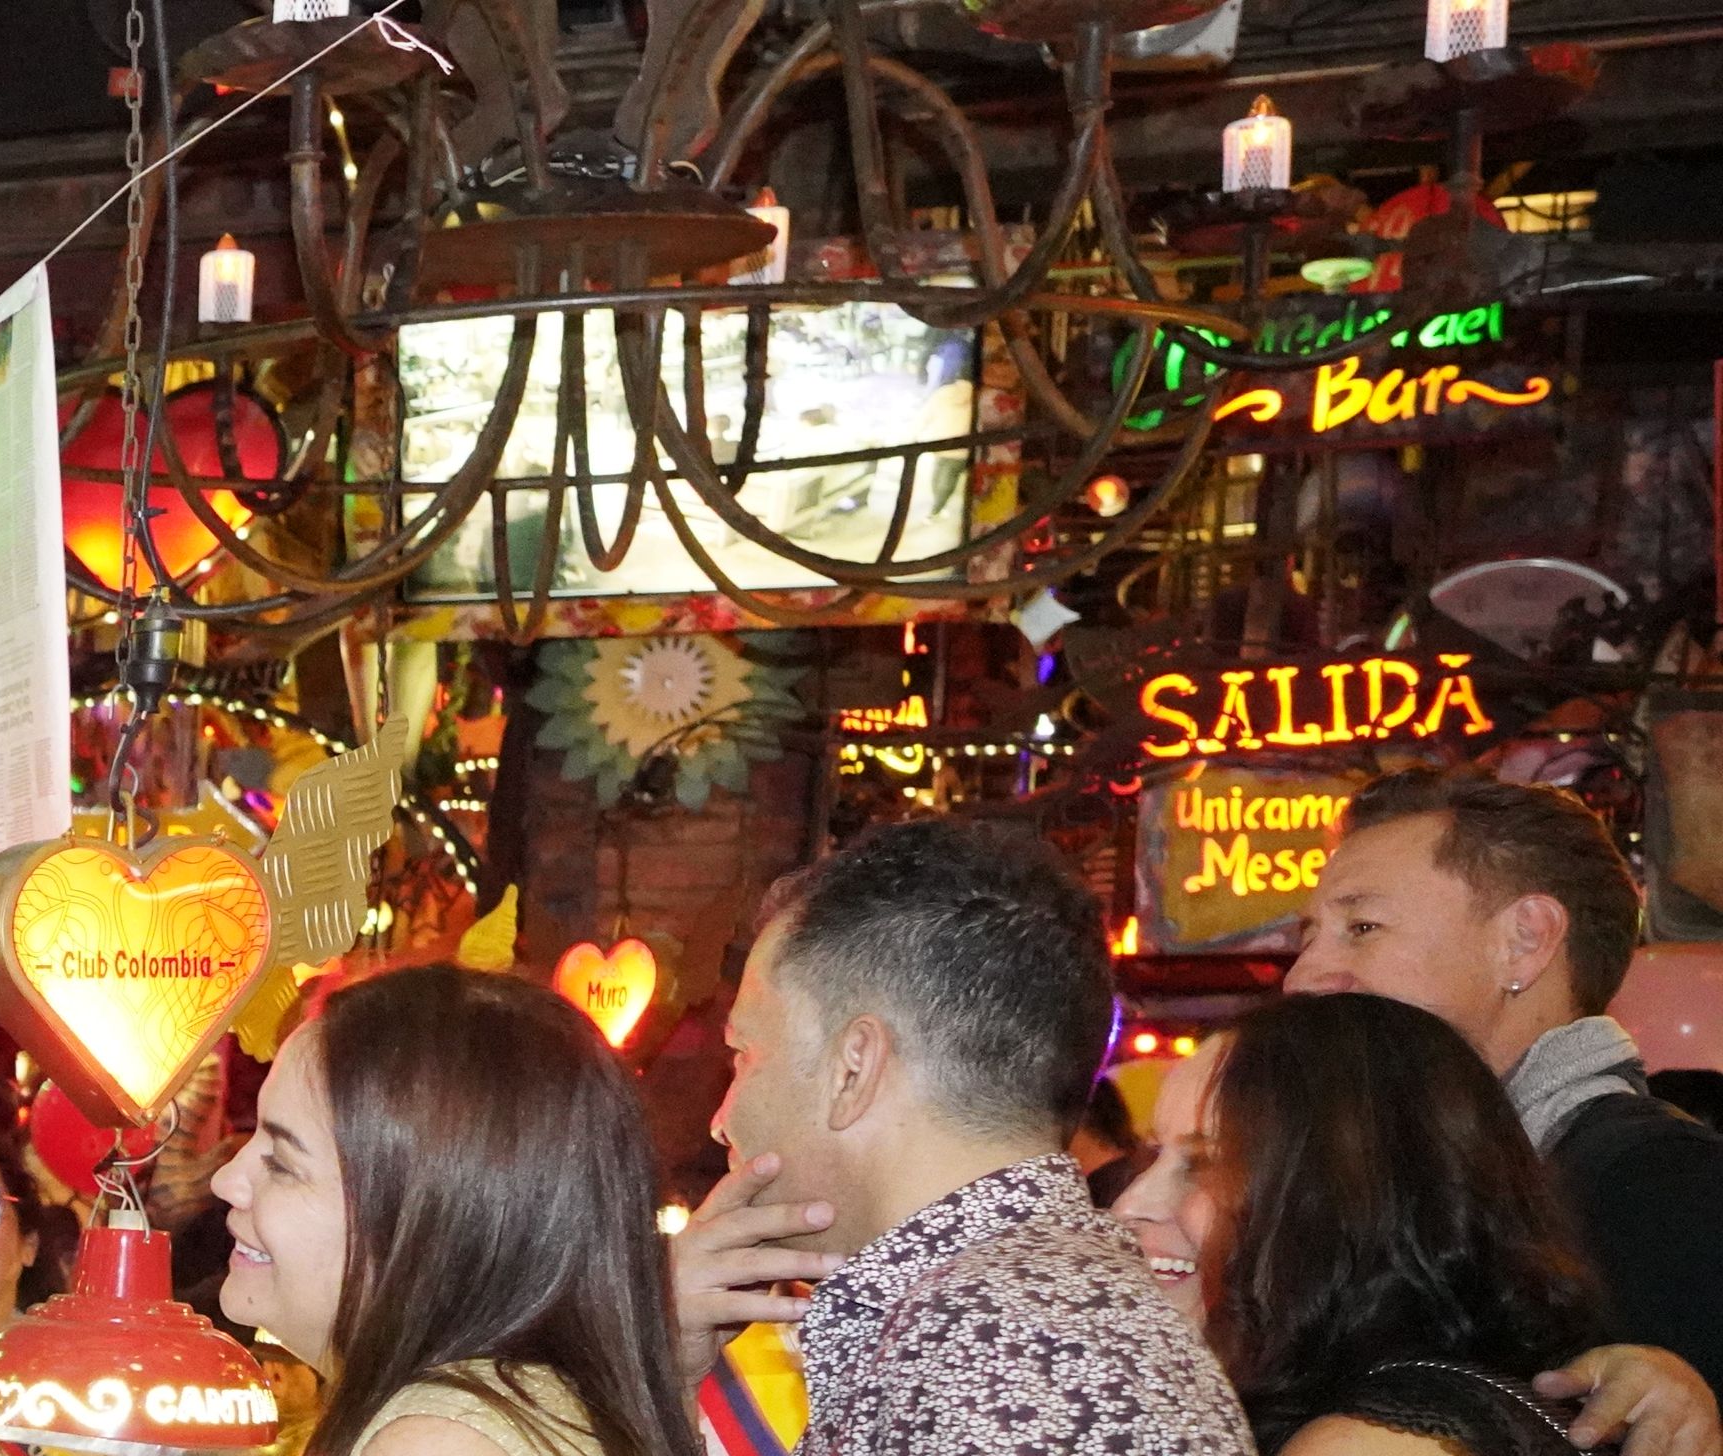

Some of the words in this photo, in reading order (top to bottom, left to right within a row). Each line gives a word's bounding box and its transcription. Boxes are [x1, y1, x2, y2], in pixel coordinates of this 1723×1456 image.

[1312, 356, 1461, 433] Bar
[1140, 653, 1494, 757] SALIDA
[1183, 832, 1335, 896] Mese
[62, 951, 107, 979] Club
[115, 949, 212, 979] Colombia
[587, 981, 628, 1010] Muro
